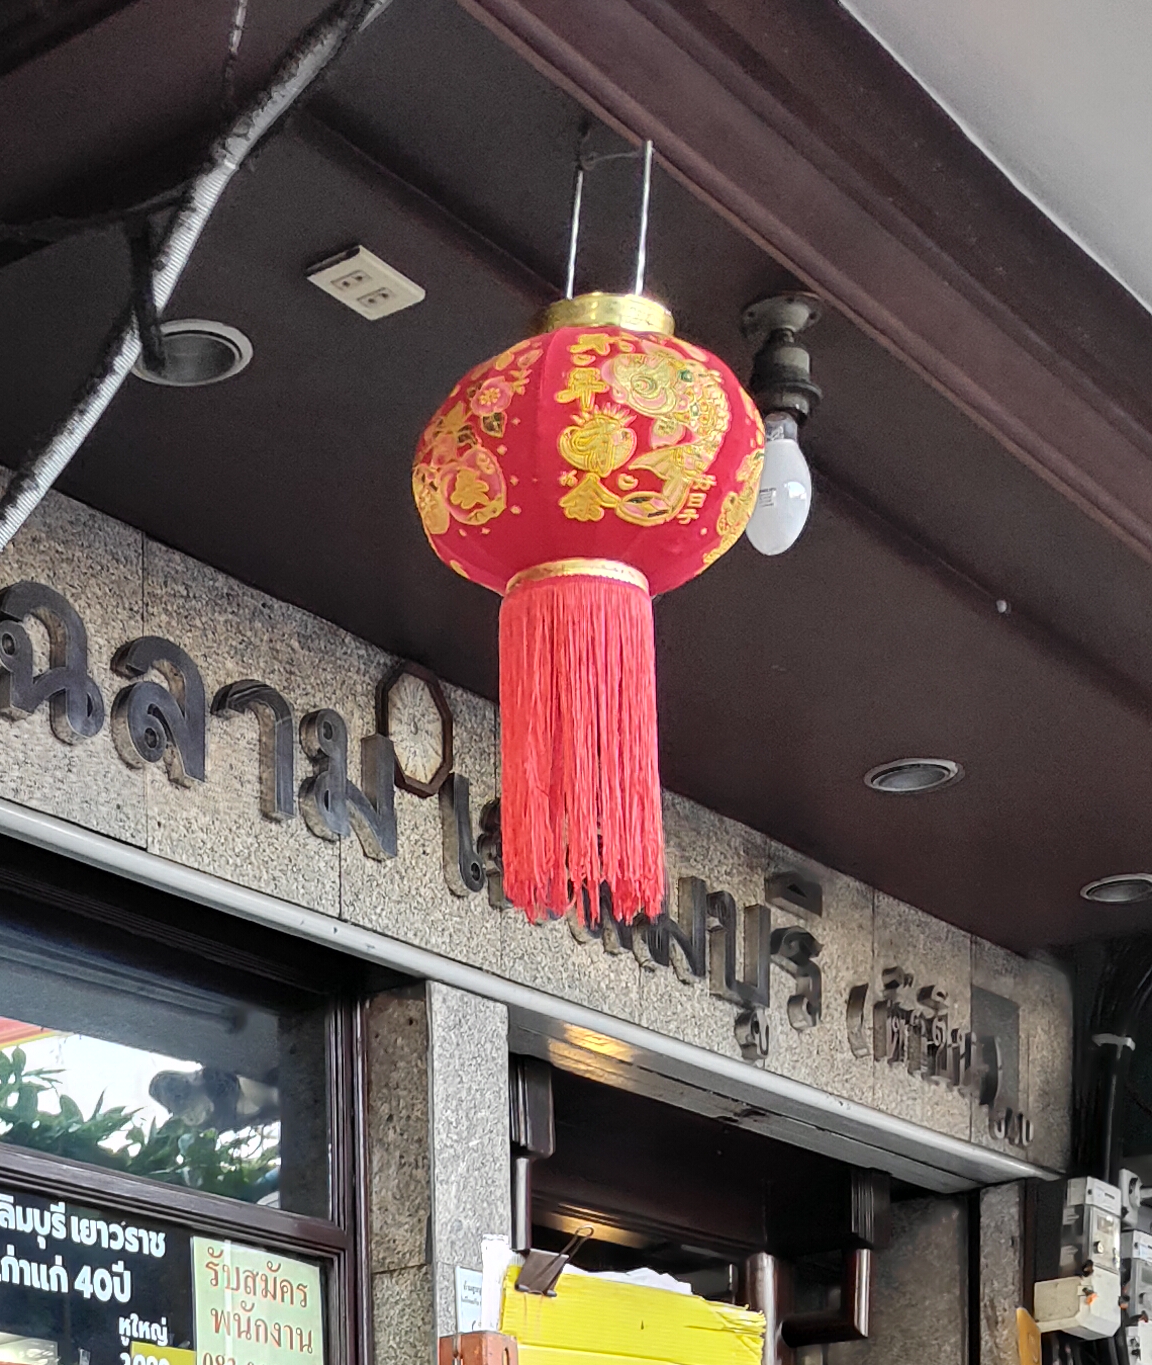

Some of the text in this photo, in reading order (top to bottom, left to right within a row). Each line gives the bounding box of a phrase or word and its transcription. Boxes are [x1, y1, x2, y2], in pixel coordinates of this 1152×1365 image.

[70, 1215, 167, 1259] เยาวราช
[73, 1260, 132, 1303] 40ปี
[204, 1246, 309, 1308] รับสมัคร
[118, 1313, 169, 1347] หูใหญ่
[209, 1300, 314, 1354] พนักงาน
